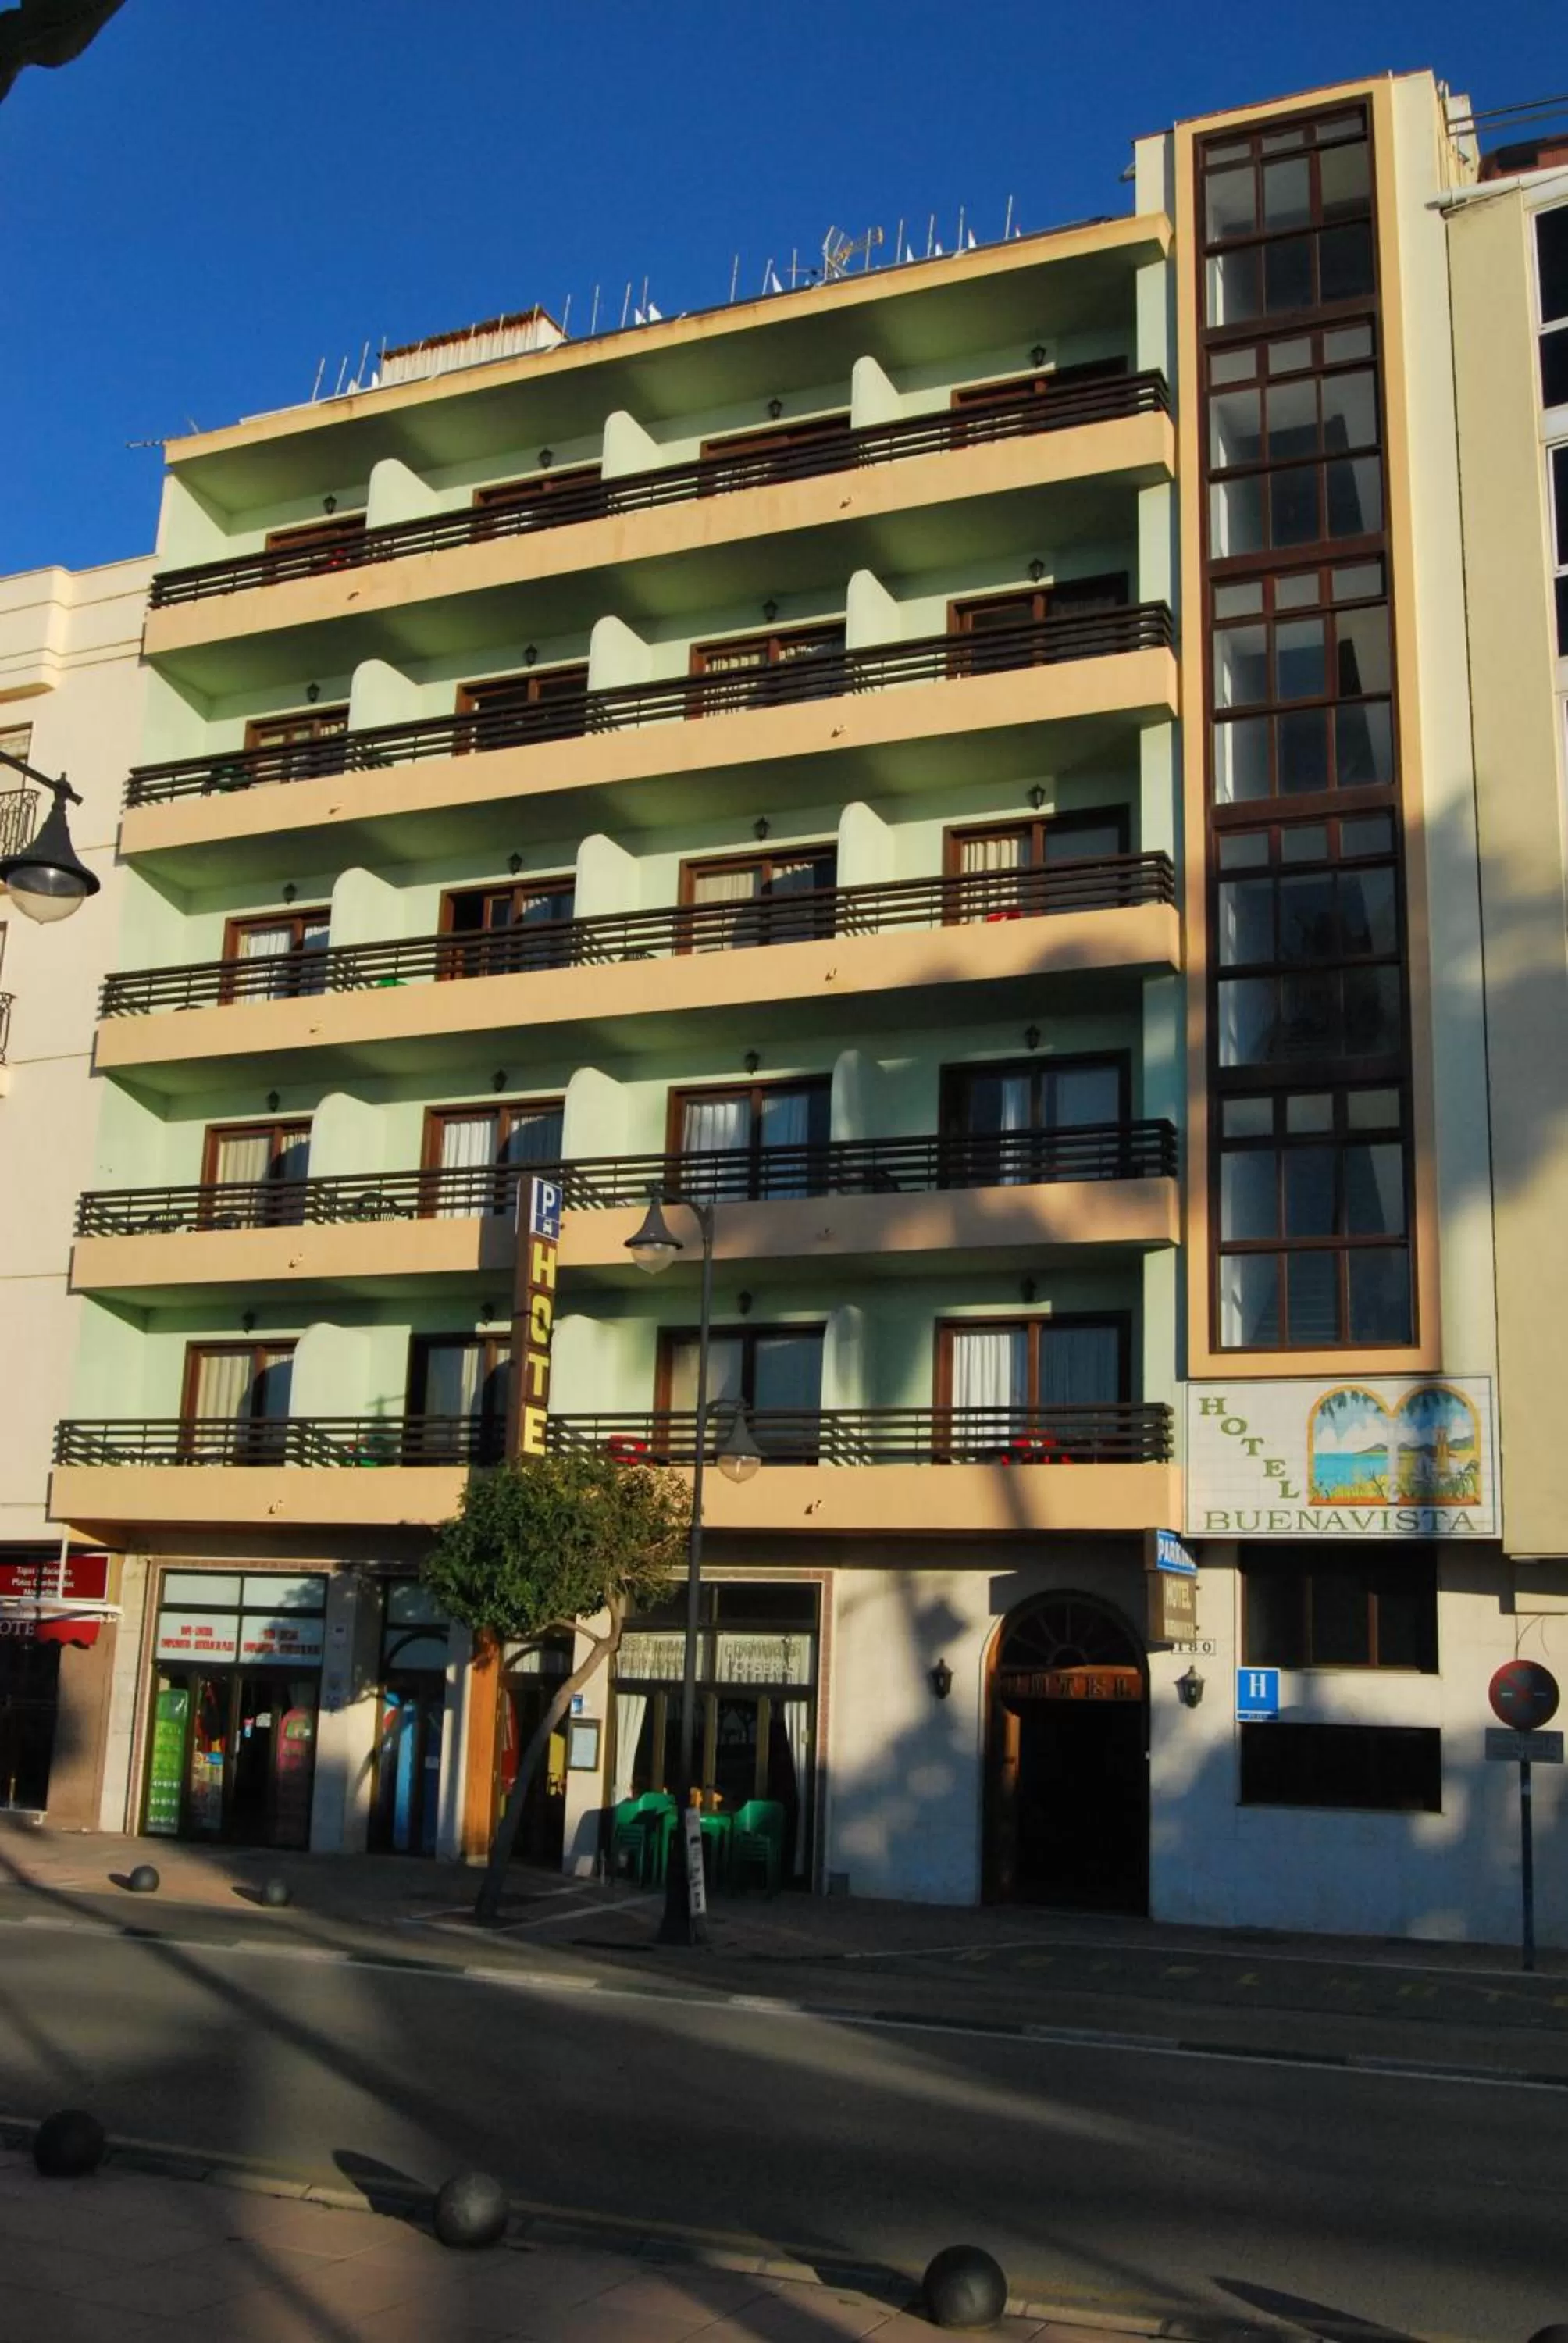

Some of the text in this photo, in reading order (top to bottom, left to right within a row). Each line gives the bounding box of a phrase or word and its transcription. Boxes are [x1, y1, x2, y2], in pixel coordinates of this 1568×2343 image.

[542, 1183, 557, 1216] P
[523, 1241, 557, 1458] HOTE
[1199, 1397, 1300, 1498] HOTEL
[1203, 1510, 1477, 1532] BUENAVISTA
[1249, 1674, 1267, 1699] H
